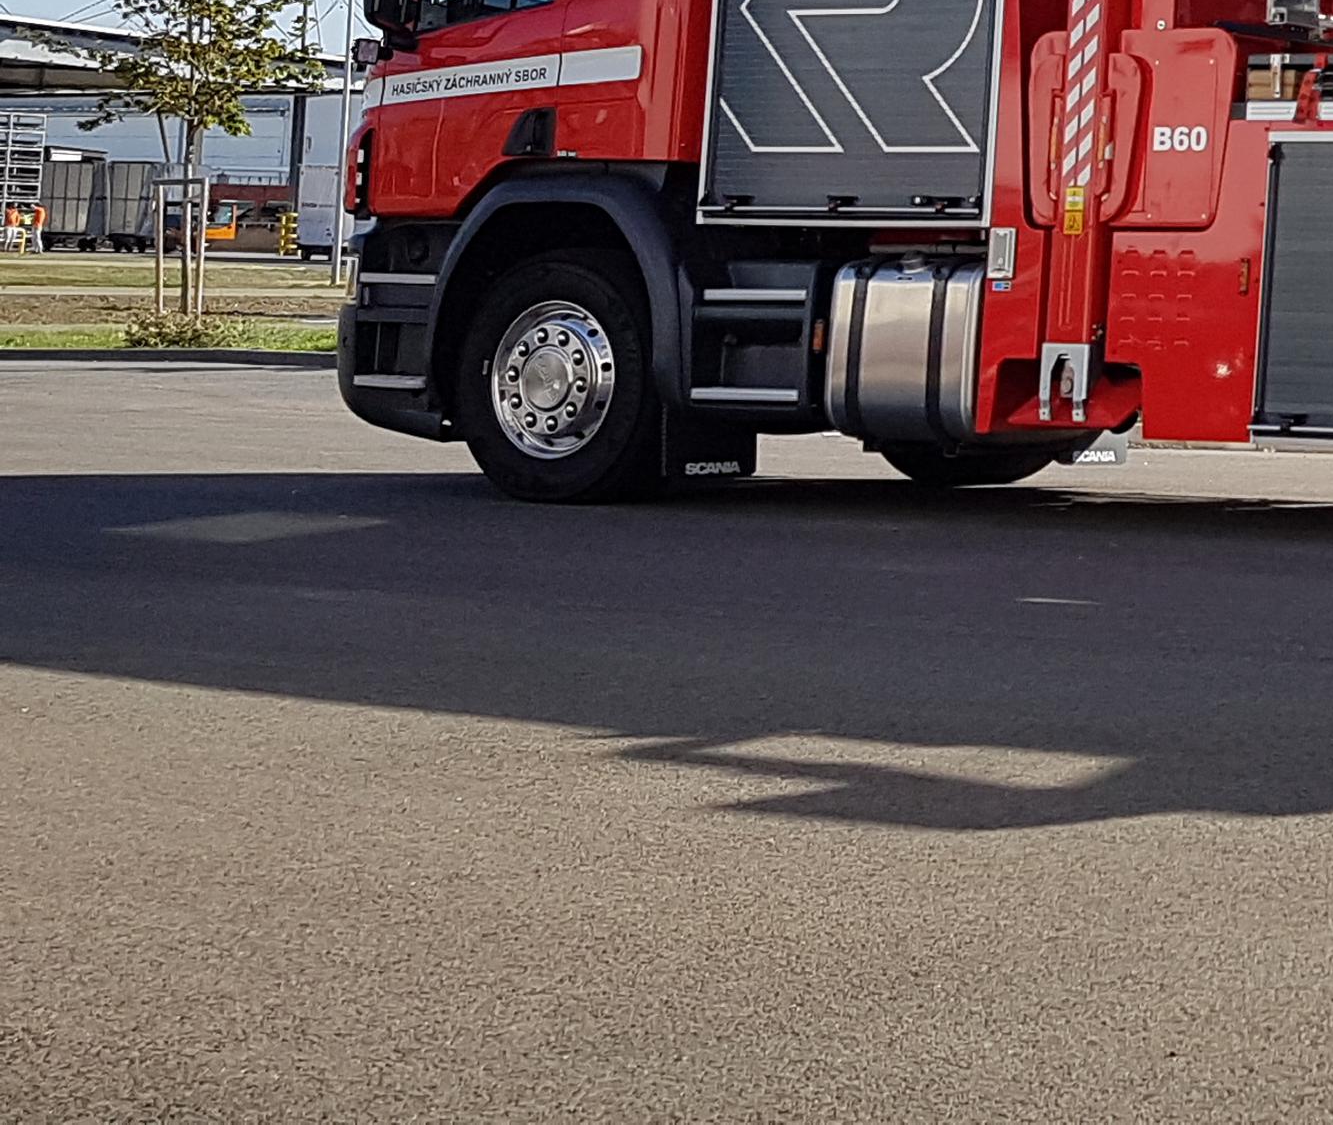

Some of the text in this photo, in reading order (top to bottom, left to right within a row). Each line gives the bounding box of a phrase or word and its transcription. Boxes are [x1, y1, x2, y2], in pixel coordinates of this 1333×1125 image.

[392, 67, 547, 96] HASIČSKÝ ZÁCHRANNÝ SBOR
[1153, 126, 1208, 152] B60
[685, 461, 741, 475] SCANIA
